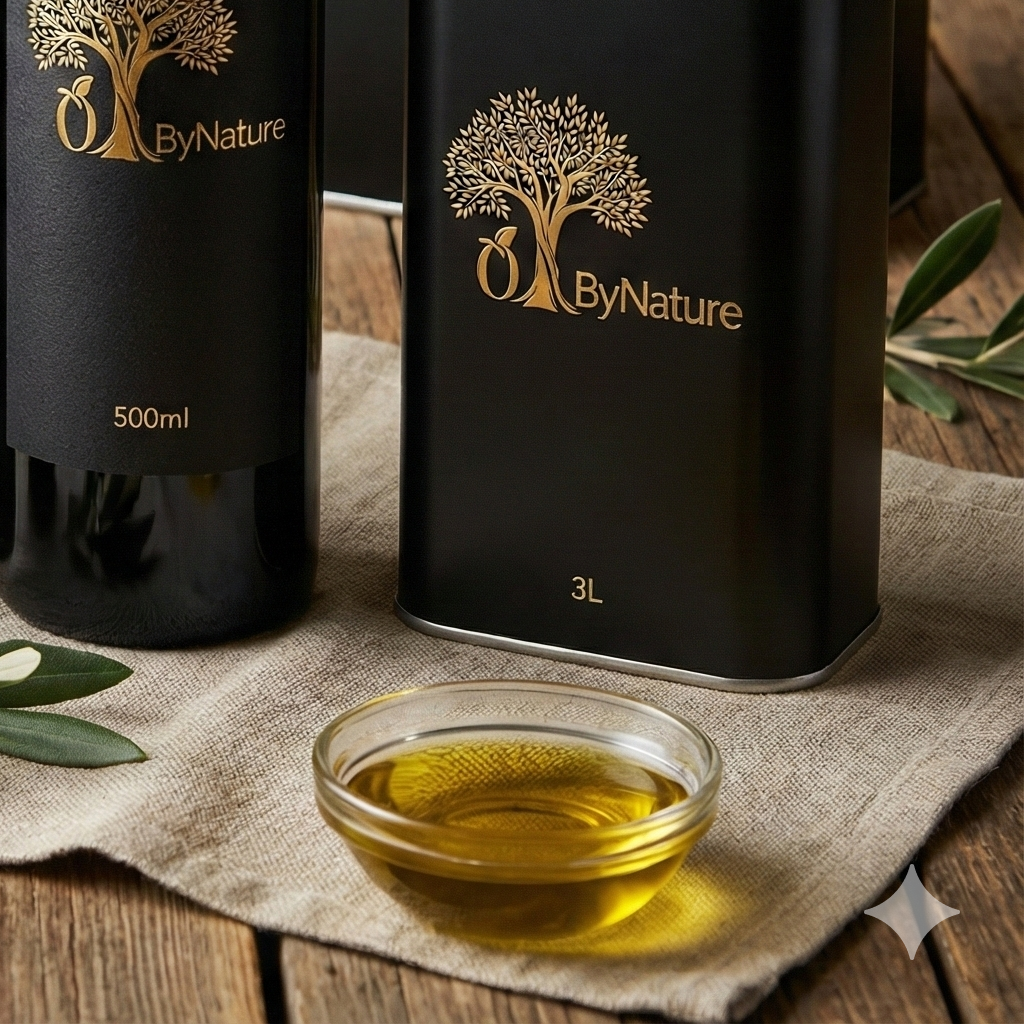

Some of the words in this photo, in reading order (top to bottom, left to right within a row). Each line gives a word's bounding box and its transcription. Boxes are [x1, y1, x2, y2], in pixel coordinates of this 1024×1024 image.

[155, 115, 286, 162] ByNature
[575, 270, 744, 330] ByNature
[113, 405, 190, 430] 500ml
[571, 575, 604, 604] 3L
